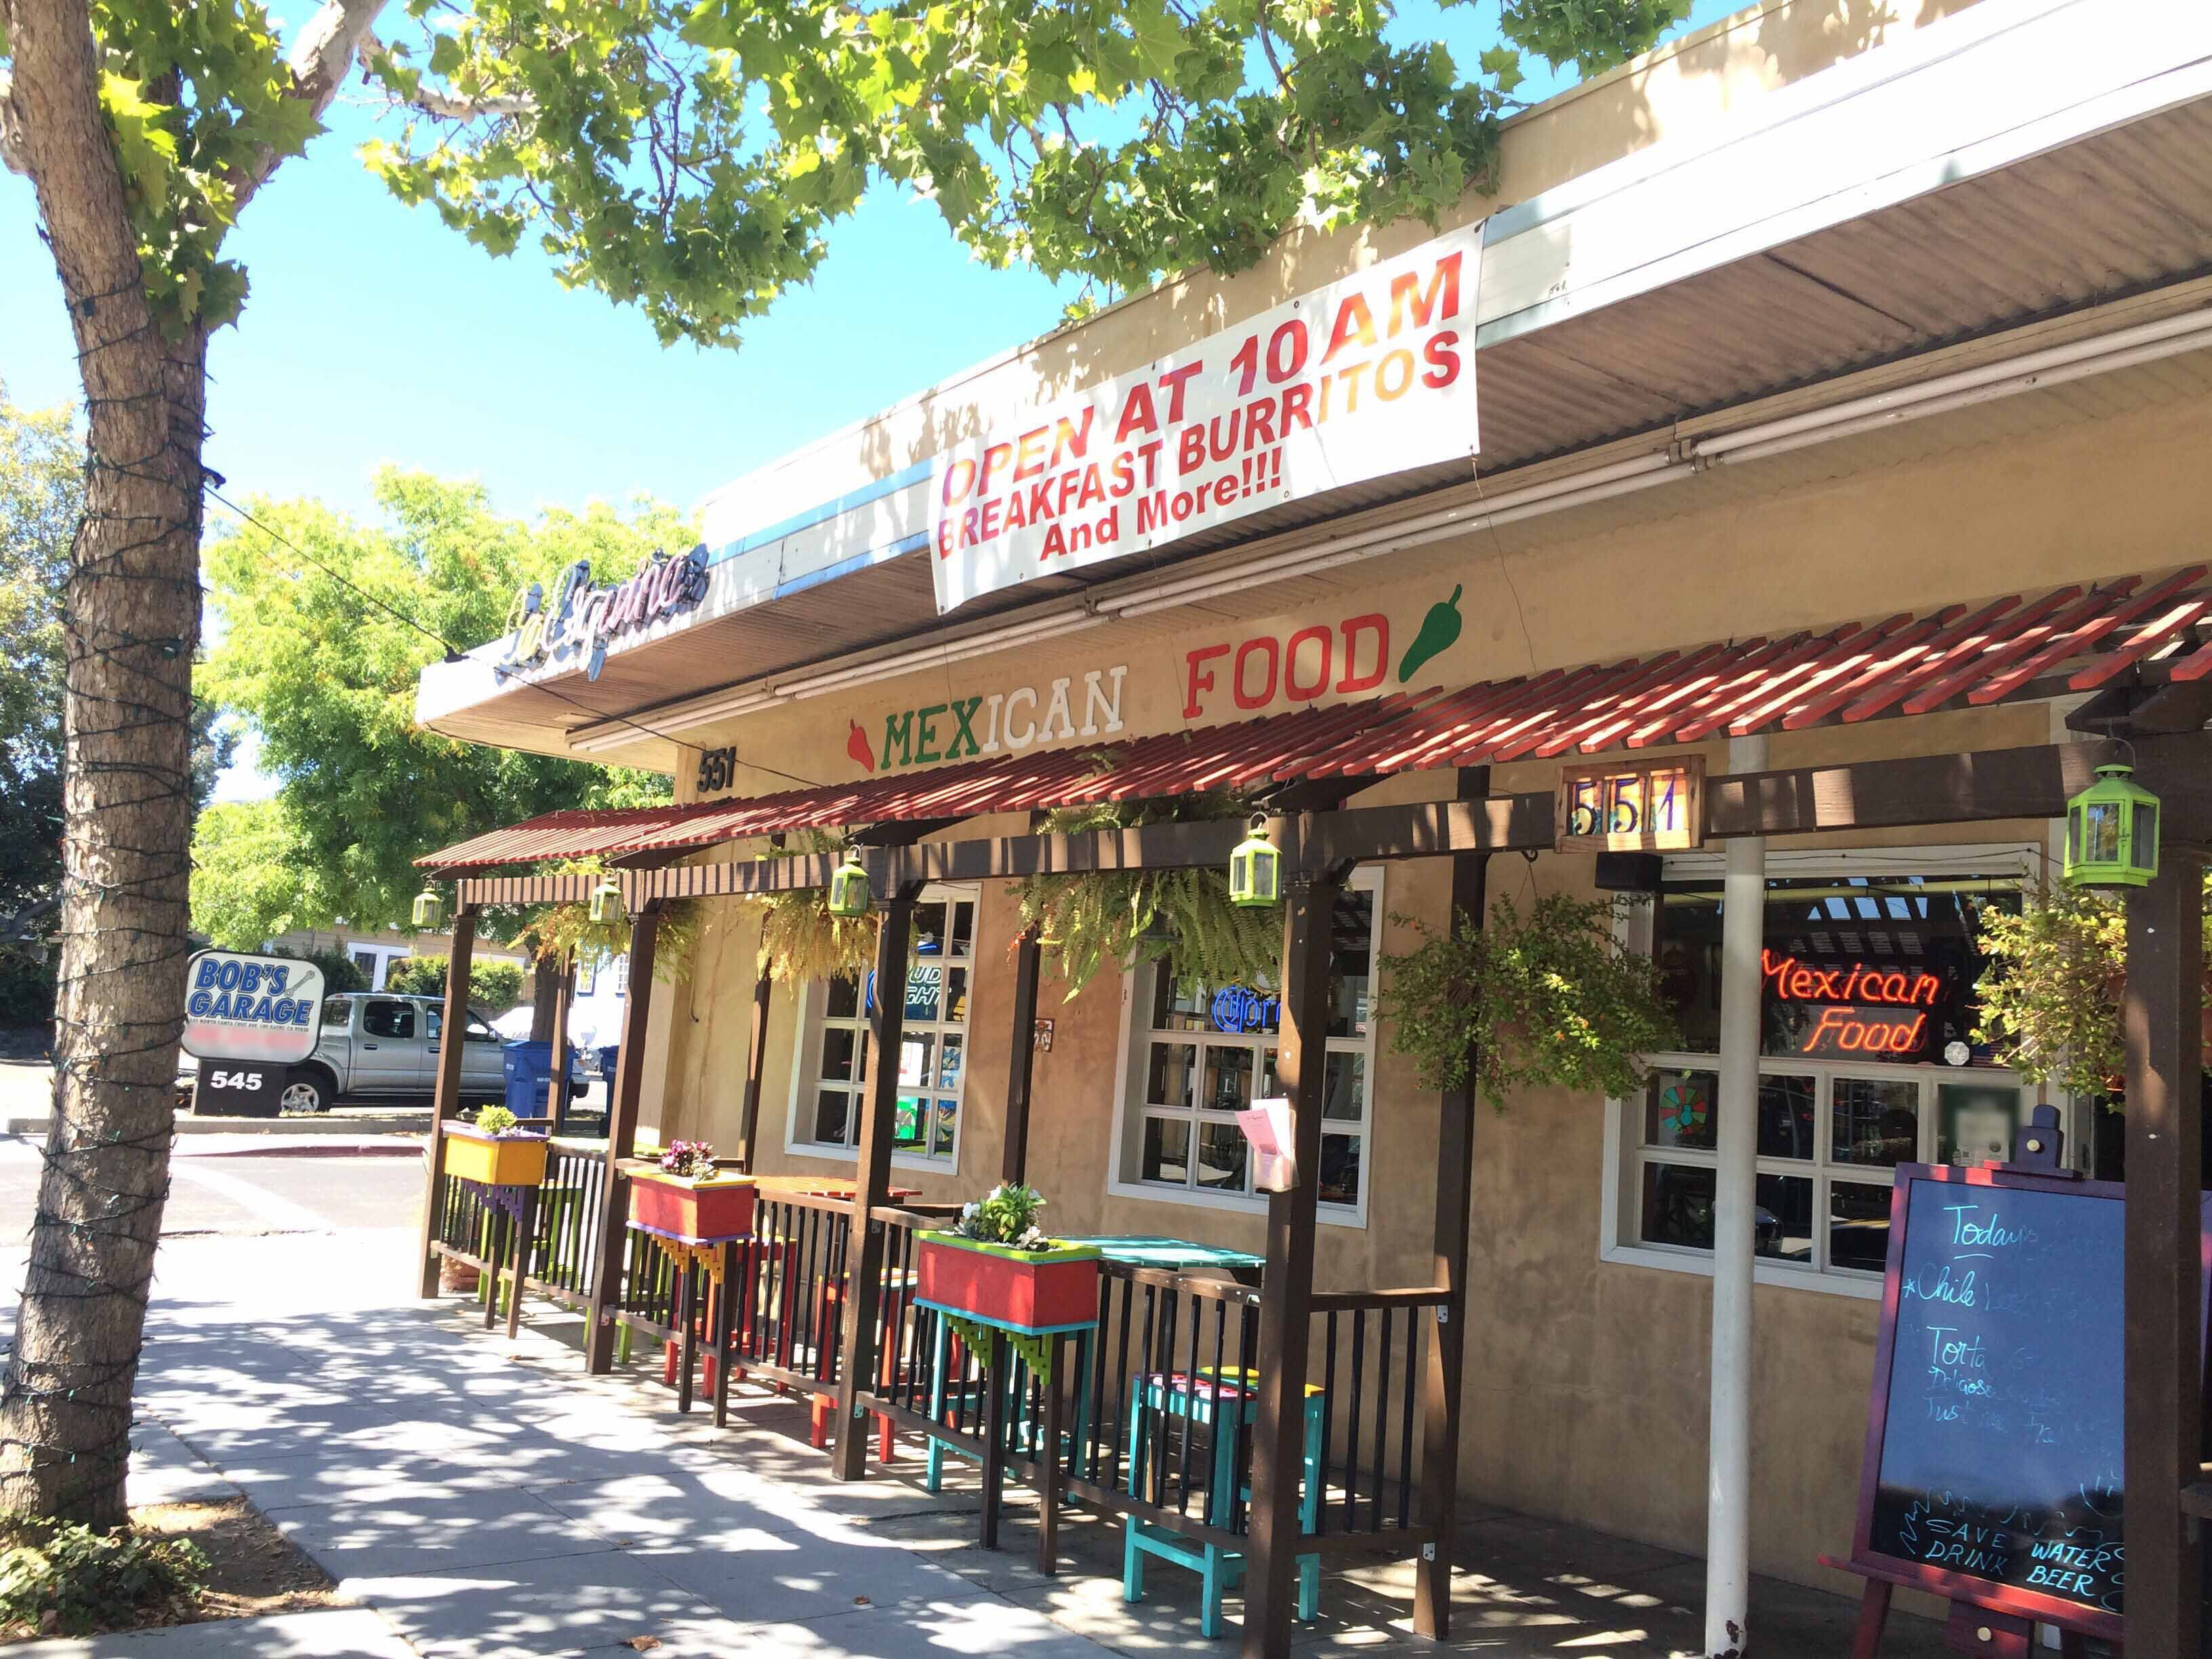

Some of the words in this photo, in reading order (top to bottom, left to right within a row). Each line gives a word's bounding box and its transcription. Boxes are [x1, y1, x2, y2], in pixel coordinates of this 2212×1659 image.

[942, 404, 1094, 507] OPEN
[1113, 359, 1204, 444] AT
[1229, 319, 1309, 398] 10
[1320, 250, 1463, 367] AM
[939, 438, 1164, 560] BREAKFAST
[1178, 330, 1462, 477] BURRITOS
[1040, 515, 1120, 562] And
[1137, 448, 1283, 534] More!!!
[879, 664, 1129, 771] MEXICAN
[1182, 612, 1390, 720] FOOD
[697, 745, 737, 793] 551
[1574, 775, 1675, 836] 551
[194, 958, 290, 997] BOB'S
[908, 965, 942, 984] UD
[1761, 949, 1940, 1005] Mexican
[188, 989, 314, 1026] GARAGE
[1803, 1006, 1927, 1053] Food
[210, 1070, 263, 1091] 545
[1925, 1519, 2007, 1549] SAVE
[2030, 1540, 2112, 1572] WATER
[1925, 1540, 2008, 1576] DRINK
[2026, 1565, 2095, 1597] BEER
